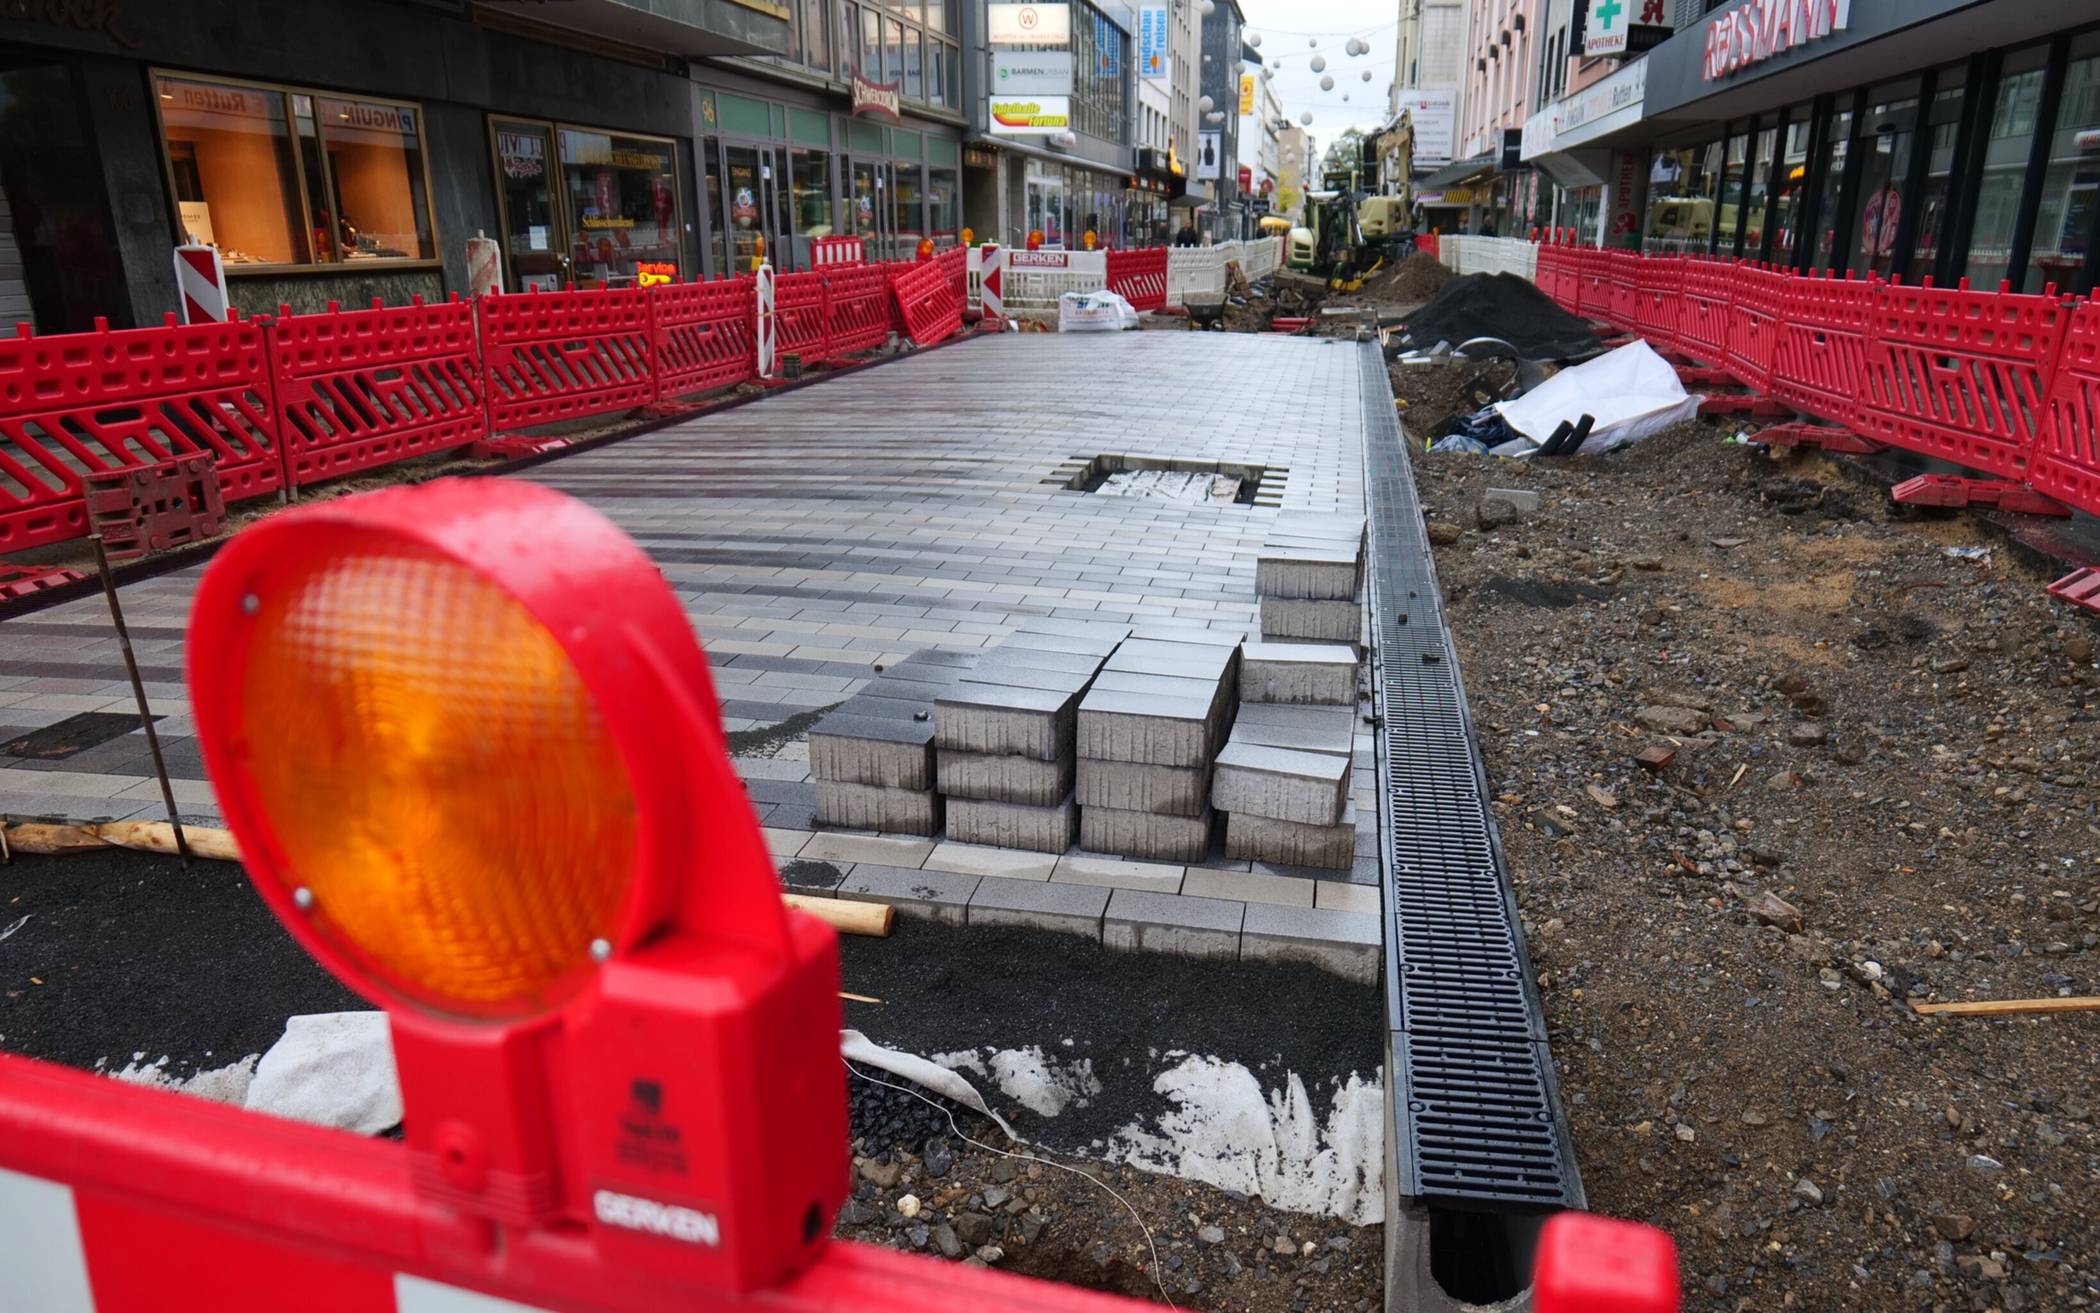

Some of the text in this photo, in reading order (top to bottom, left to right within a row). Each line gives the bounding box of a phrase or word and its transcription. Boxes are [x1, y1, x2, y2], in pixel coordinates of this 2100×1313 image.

[1156, 10, 1165, 48] reisen
[1142, 10, 1152, 73] rundschau
[1587, 34, 1625, 50] APOTHEKE
[853, 76, 899, 117] SCHWEBODROM
[992, 102, 1040, 114] Spielhalle
[1028, 115, 1067, 127] Fortuna
[1013, 252, 1065, 265] GERKEN
[636, 260, 677, 274] Service
[593, 1189, 720, 1247] GERKEN
